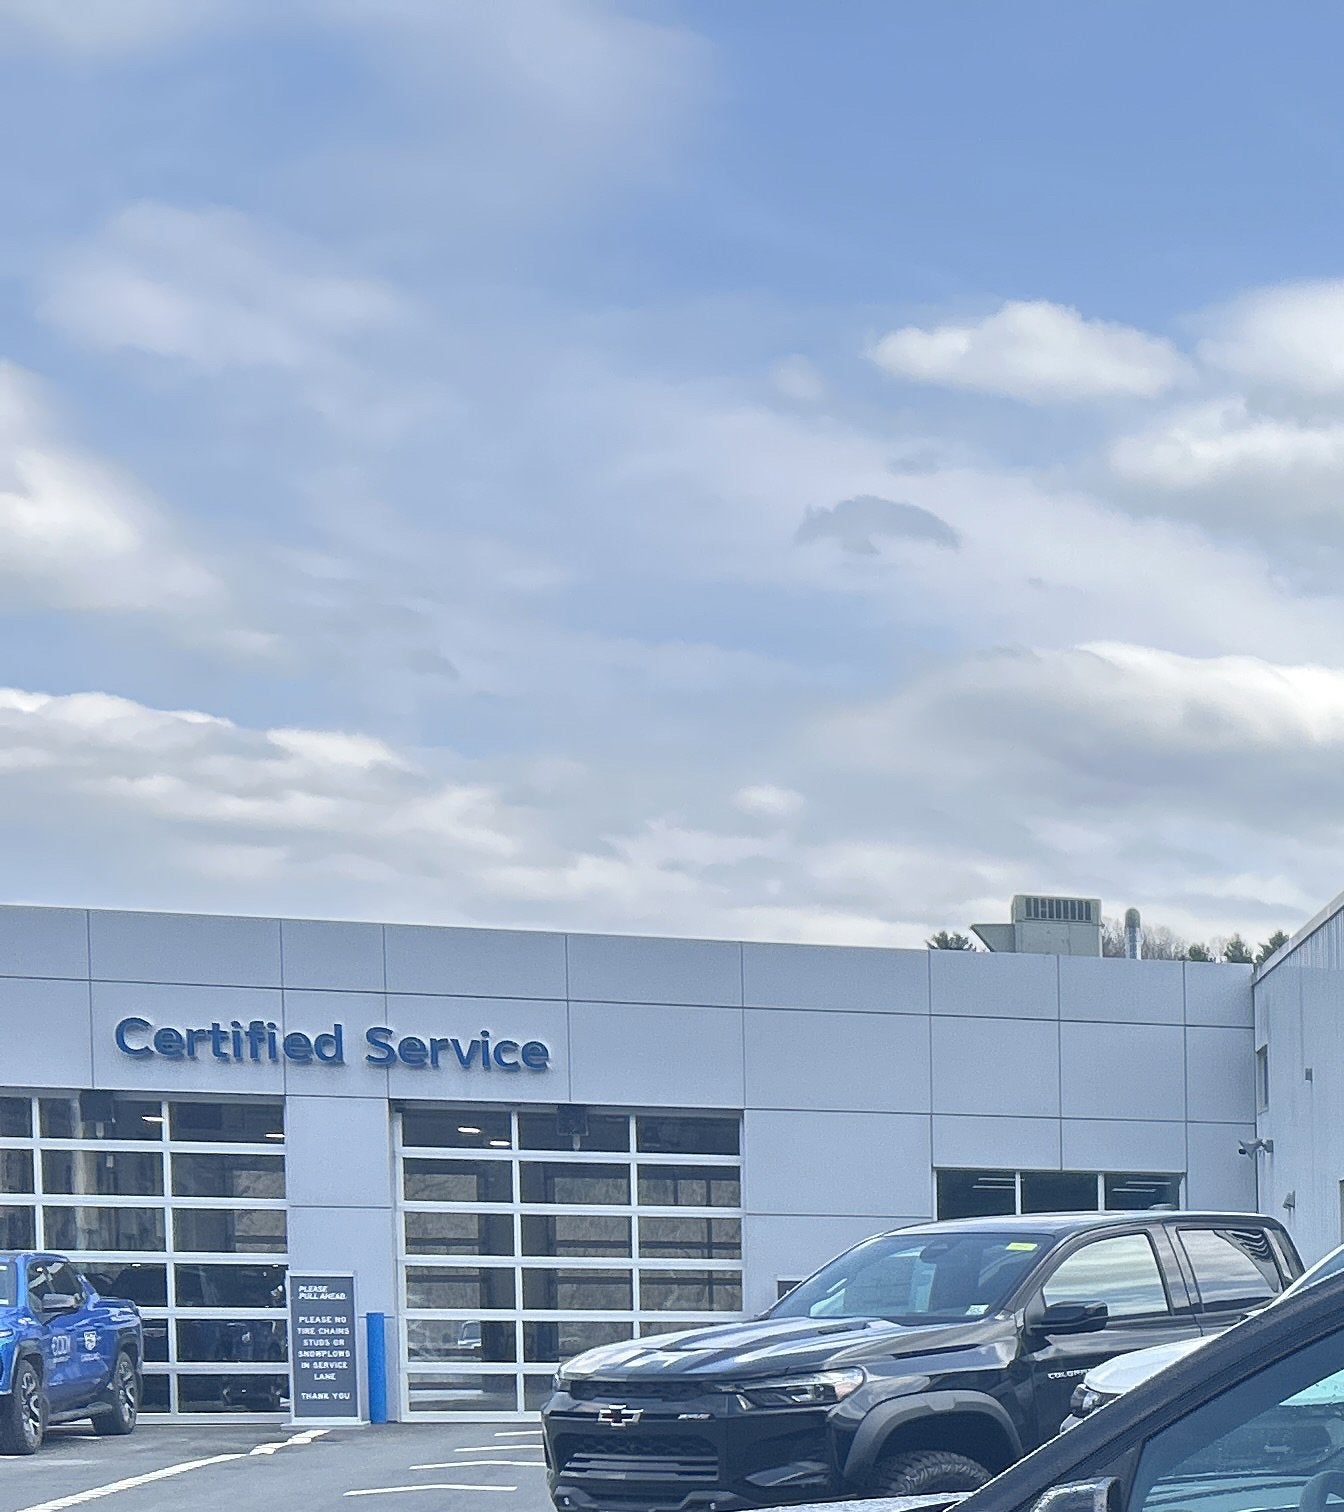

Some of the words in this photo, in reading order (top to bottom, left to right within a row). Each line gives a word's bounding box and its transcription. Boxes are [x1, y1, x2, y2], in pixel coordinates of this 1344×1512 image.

[114, 1016, 345, 1064] Certified
[365, 1026, 551, 1070] Service
[298, 1285, 328, 1293] PLEASE
[298, 1292, 319, 1300] PULL
[298, 1316, 332, 1324] PLEASE
[334, 1316, 347, 1324] NO
[297, 1327, 316, 1335] TIRE
[318, 1327, 350, 1335] CHAINS
[303, 1339, 331, 1347] STUDS
[297, 1350, 351, 1358] SNOWPLOWS
[301, 1361, 310, 1369] IN
[313, 1361, 349, 1369] SERVICE
[313, 1372, 337, 1381] LANE
[1047, 1368, 1090, 1380] COLOR
[301, 1392, 330, 1400] THANK
[332, 1392, 351, 1400] YOU
